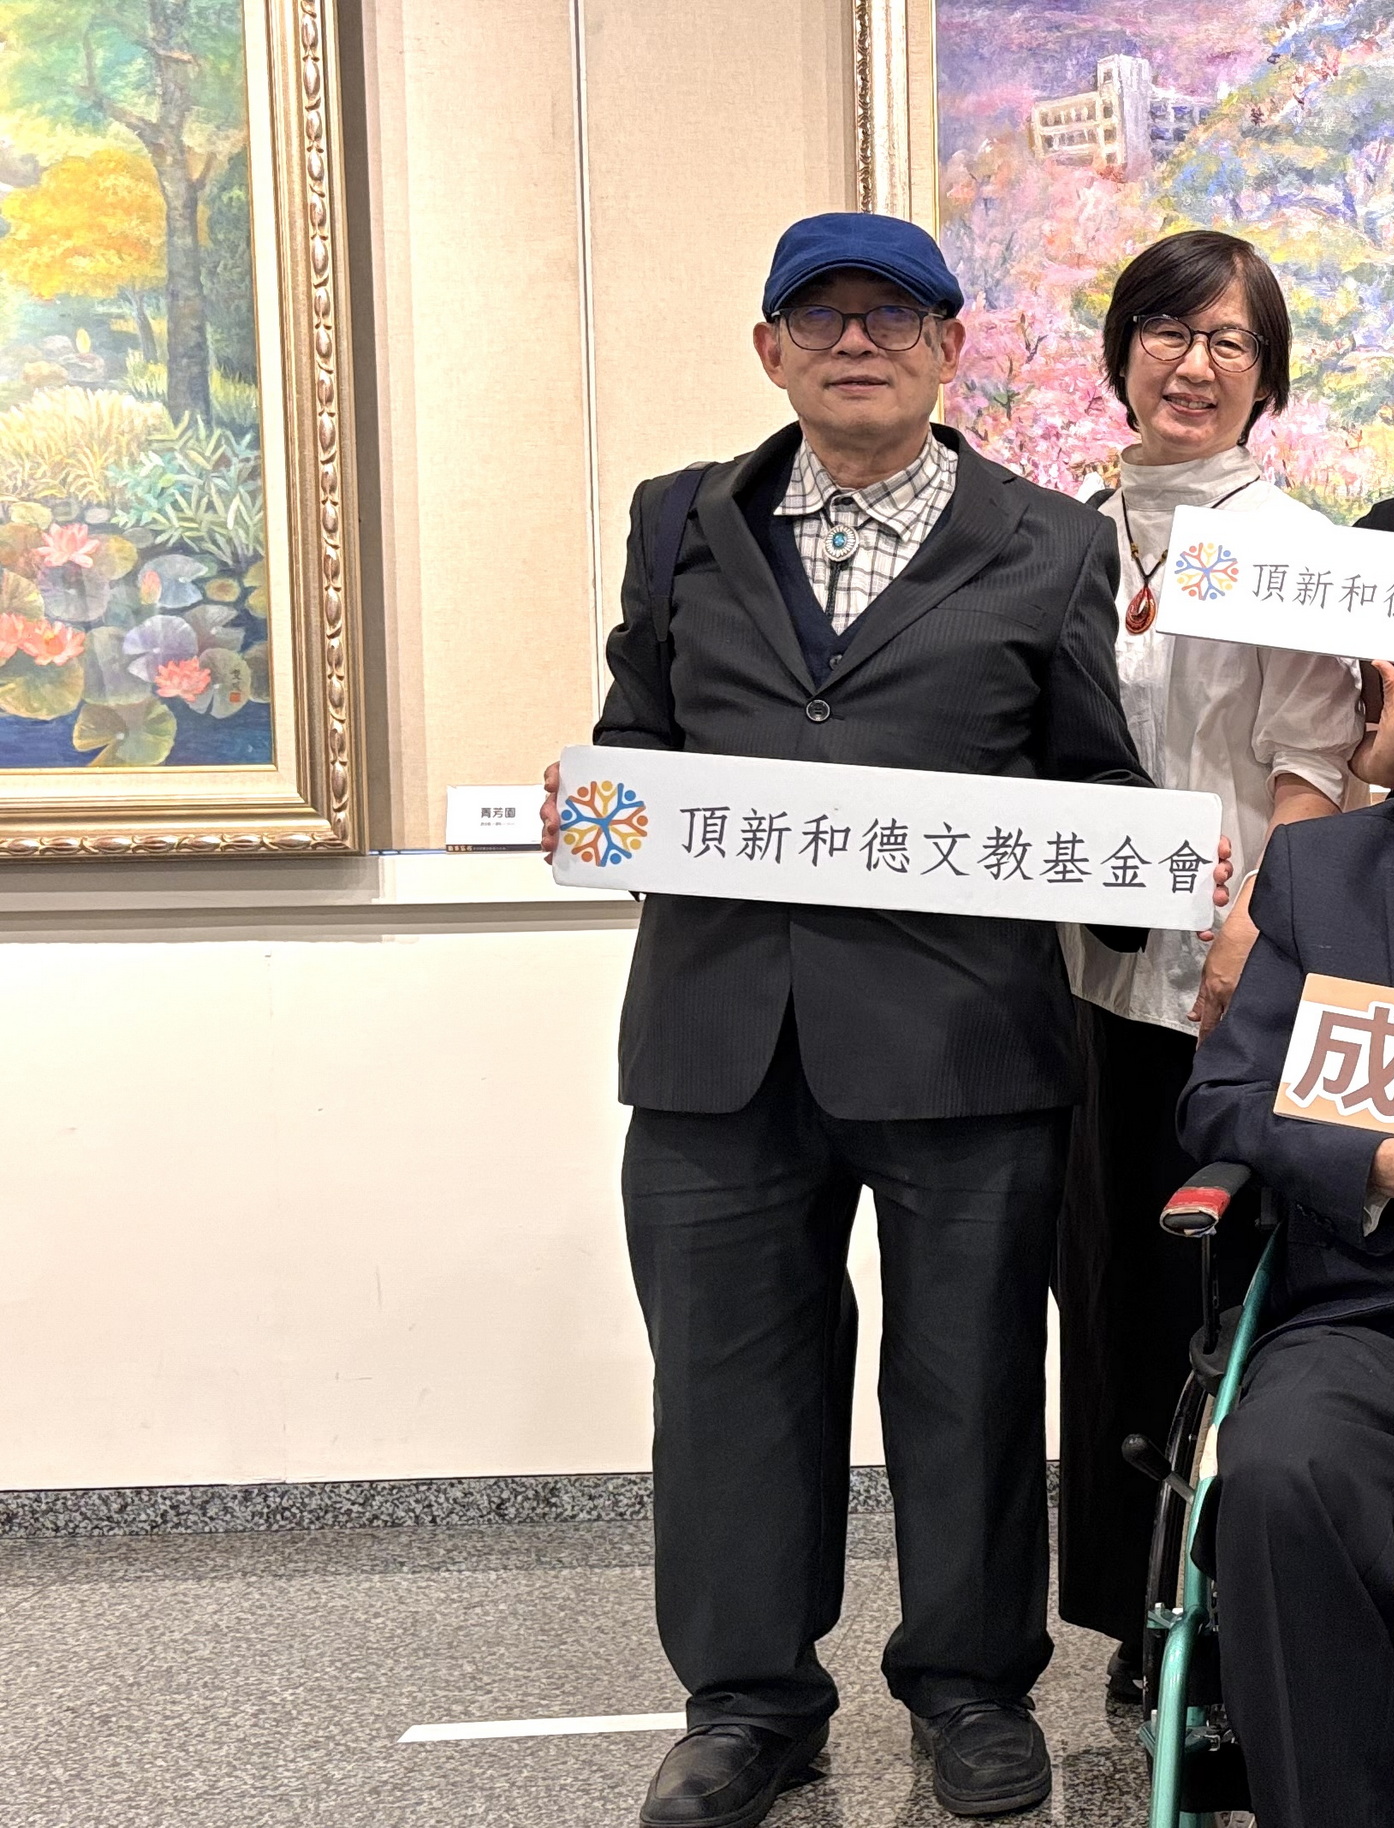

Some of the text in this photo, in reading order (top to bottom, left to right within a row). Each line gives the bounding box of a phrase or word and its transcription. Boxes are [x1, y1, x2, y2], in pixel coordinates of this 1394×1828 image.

[678, 805, 1214, 894] 頂新和德文教基金會
